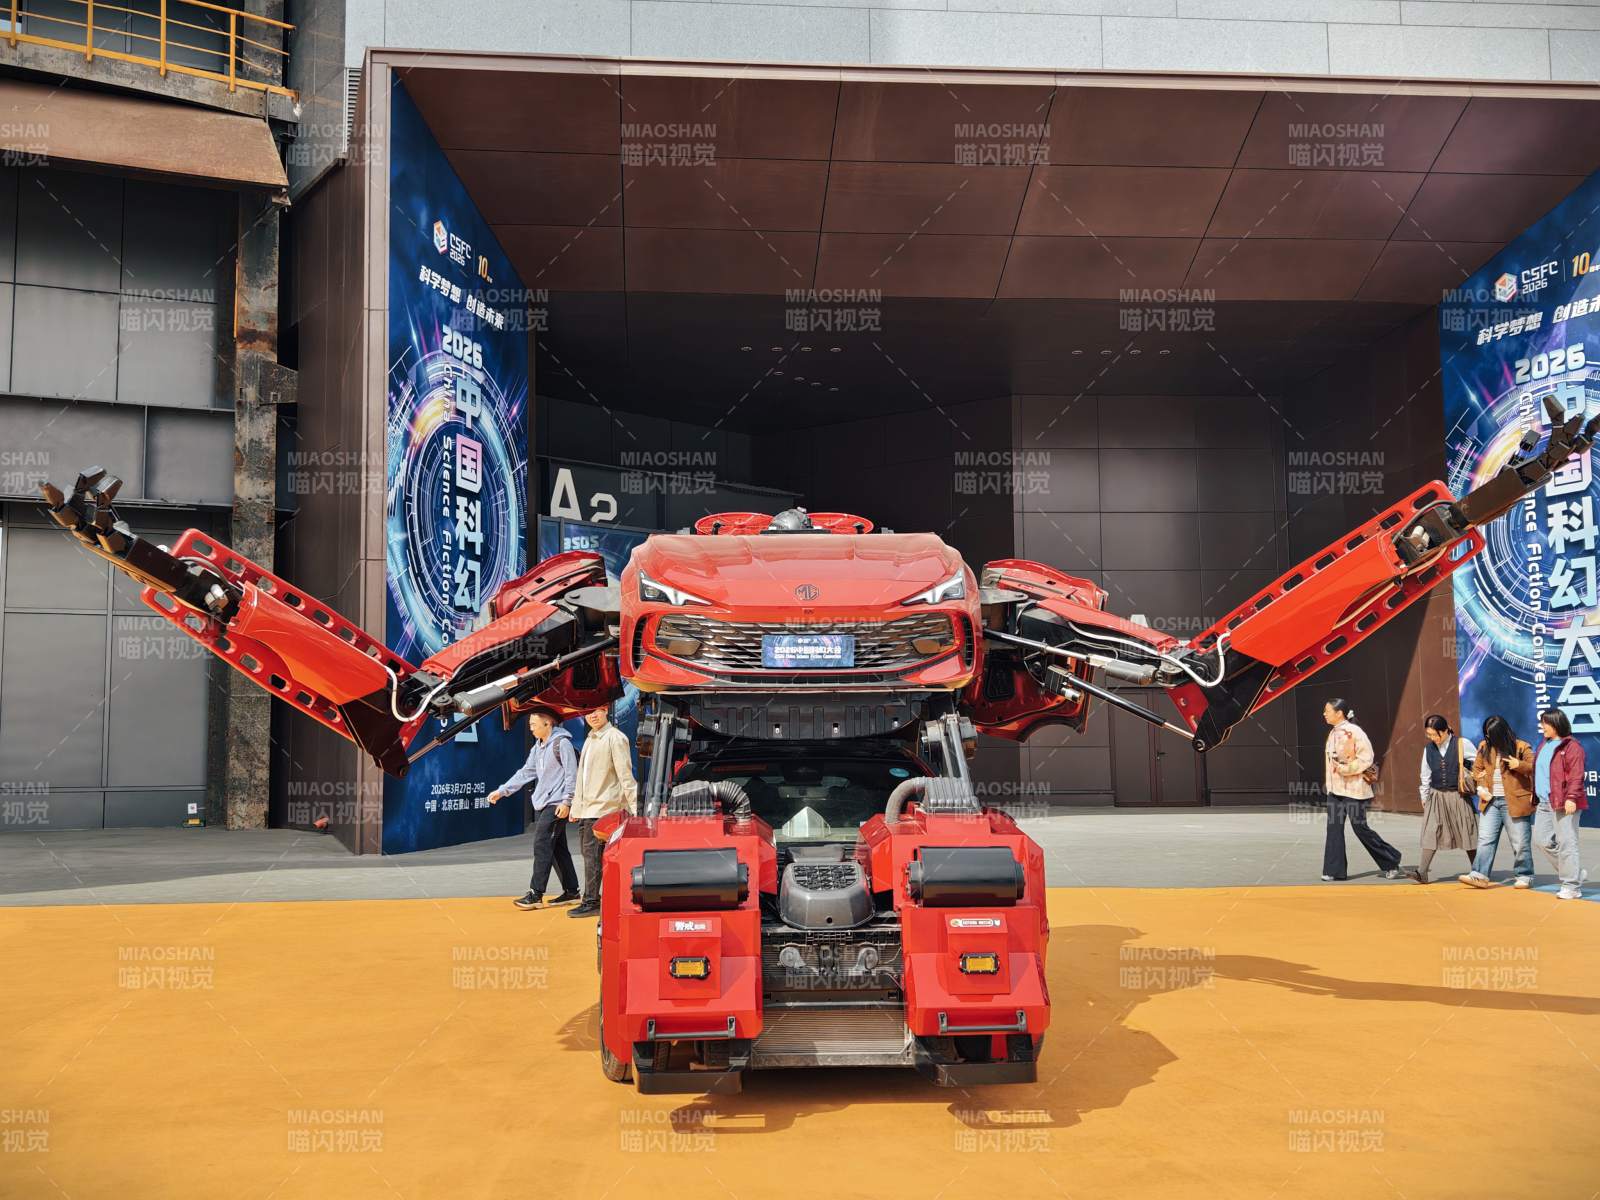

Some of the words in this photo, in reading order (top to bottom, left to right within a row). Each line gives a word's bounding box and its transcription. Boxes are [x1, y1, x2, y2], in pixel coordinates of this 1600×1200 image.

[449, 248, 466, 267] 2026
[450, 232, 472, 259] CSFC
[478, 255, 489, 279] 10
[1521, 261, 1558, 285] CSFC
[1572, 251, 1591, 278] 10
[419, 265, 462, 304] 科学梦想
[465, 294, 505, 330] 创造未来
[1522, 278, 1548, 294] 2026
[1477, 312, 1544, 346] 科学梦想
[442, 324, 483, 370] 2026
[1515, 342, 1586, 385] 2026
[443, 435, 452, 518] Science
[442, 530, 452, 605] Fiction
[1527, 543, 1543, 612] Fiction
[795, 584, 819, 600] MG
[1532, 622, 1551, 734] Conventi
